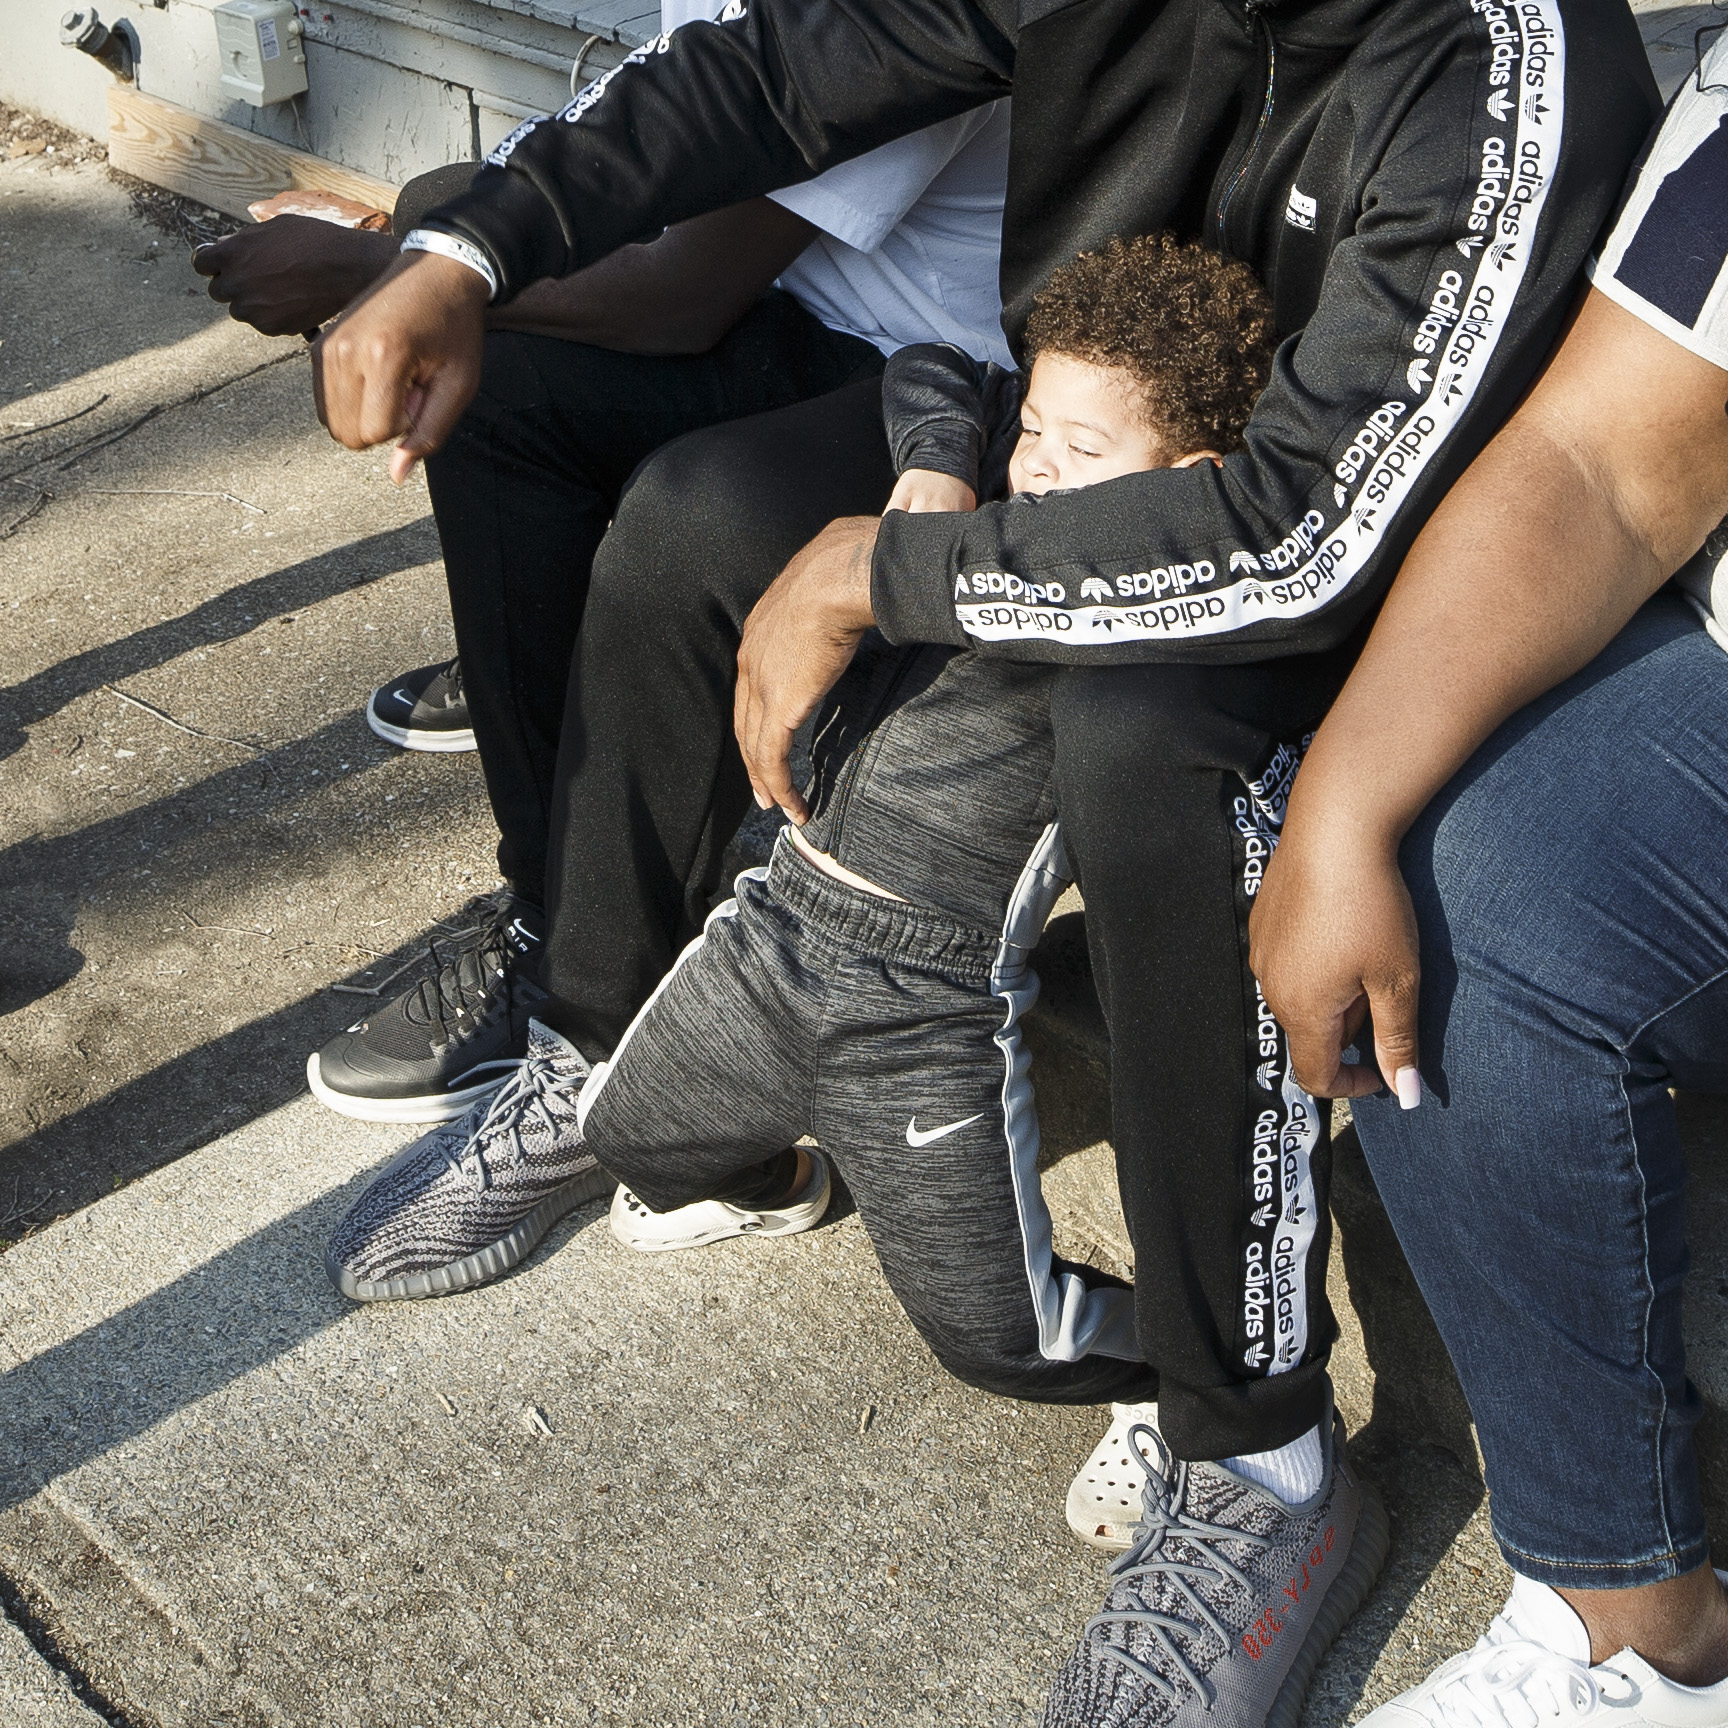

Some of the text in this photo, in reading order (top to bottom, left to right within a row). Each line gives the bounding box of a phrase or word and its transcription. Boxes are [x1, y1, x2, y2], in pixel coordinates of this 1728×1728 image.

[1484, 7, 1521, 86] adidas
[1521, 4, 1555, 88] adidas
[1468, 136, 1511, 231] adidas
[1501, 140, 1544, 237] adidas
[1413, 270, 1463, 354] adidas
[1449, 285, 1495, 368] adidas
[1335, 400, 1407, 485] adidas
[1367, 415, 1435, 504] adidas
[1116, 559, 1216, 599] adidas
[1260, 509, 1325, 572] adidas
[1272, 539, 1348, 605] adidas
[972, 571, 1067, 604] adidas
[978, 607, 1073, 633] adidas
[1125, 596, 1226, 632] adidas
[1234, 796, 1268, 896] adidas
[1253, 1109, 1278, 1202] adidas
[1275, 1101, 1311, 1336] adidas adidas
[1245, 1241, 1271, 1339] adidas
